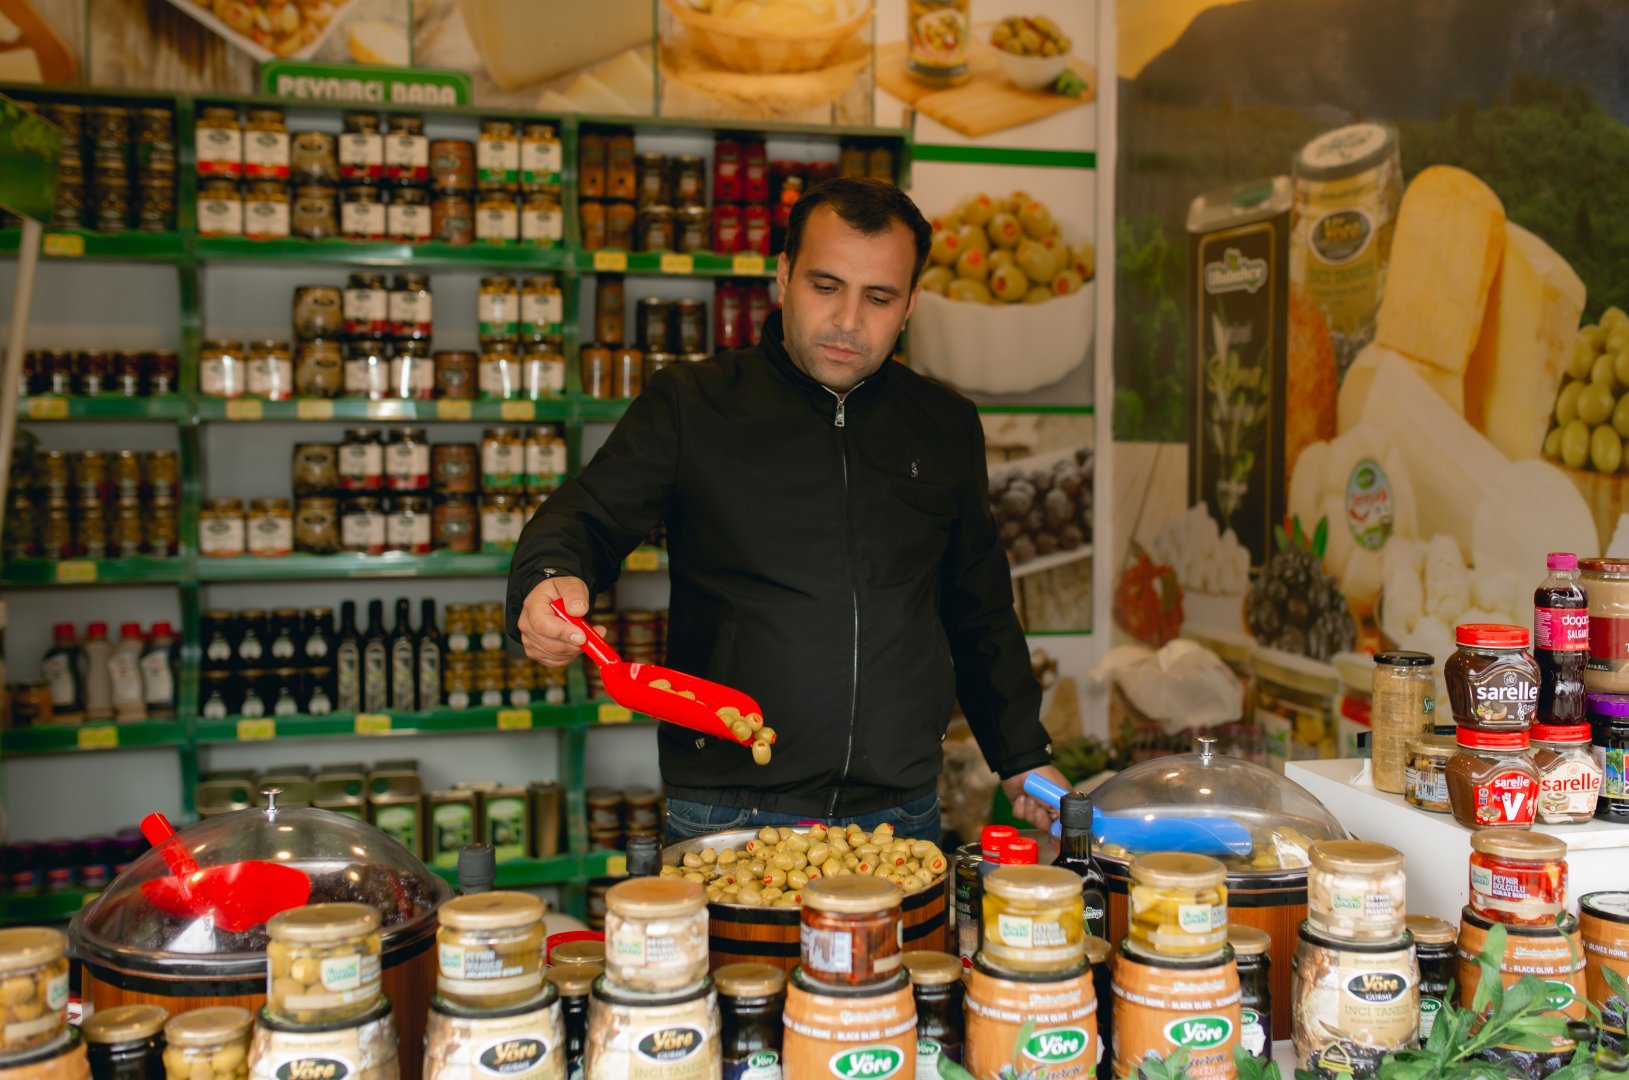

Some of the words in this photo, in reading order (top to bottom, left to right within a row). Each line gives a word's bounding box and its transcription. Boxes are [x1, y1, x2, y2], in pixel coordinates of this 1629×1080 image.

[1477, 681, 1538, 700] sarelle
[1494, 776, 1530, 788] sarelle
[1541, 773, 1600, 792] sarelle
[1588, 943, 1608, 954] OLIVES
[1608, 948, 1628, 958] NOIRE
[1514, 965, 1535, 974] BLACK
[1536, 966, 1554, 974] OLIVE
[1362, 974, 1399, 993] Yöre
[652, 1029, 694, 1053] Yöre
[1181, 1021, 1223, 1045] Yöre
[493, 1041, 538, 1066] Yöre
[1037, 1034, 1079, 1058] Yöre
[847, 1052, 892, 1077] Yöre
